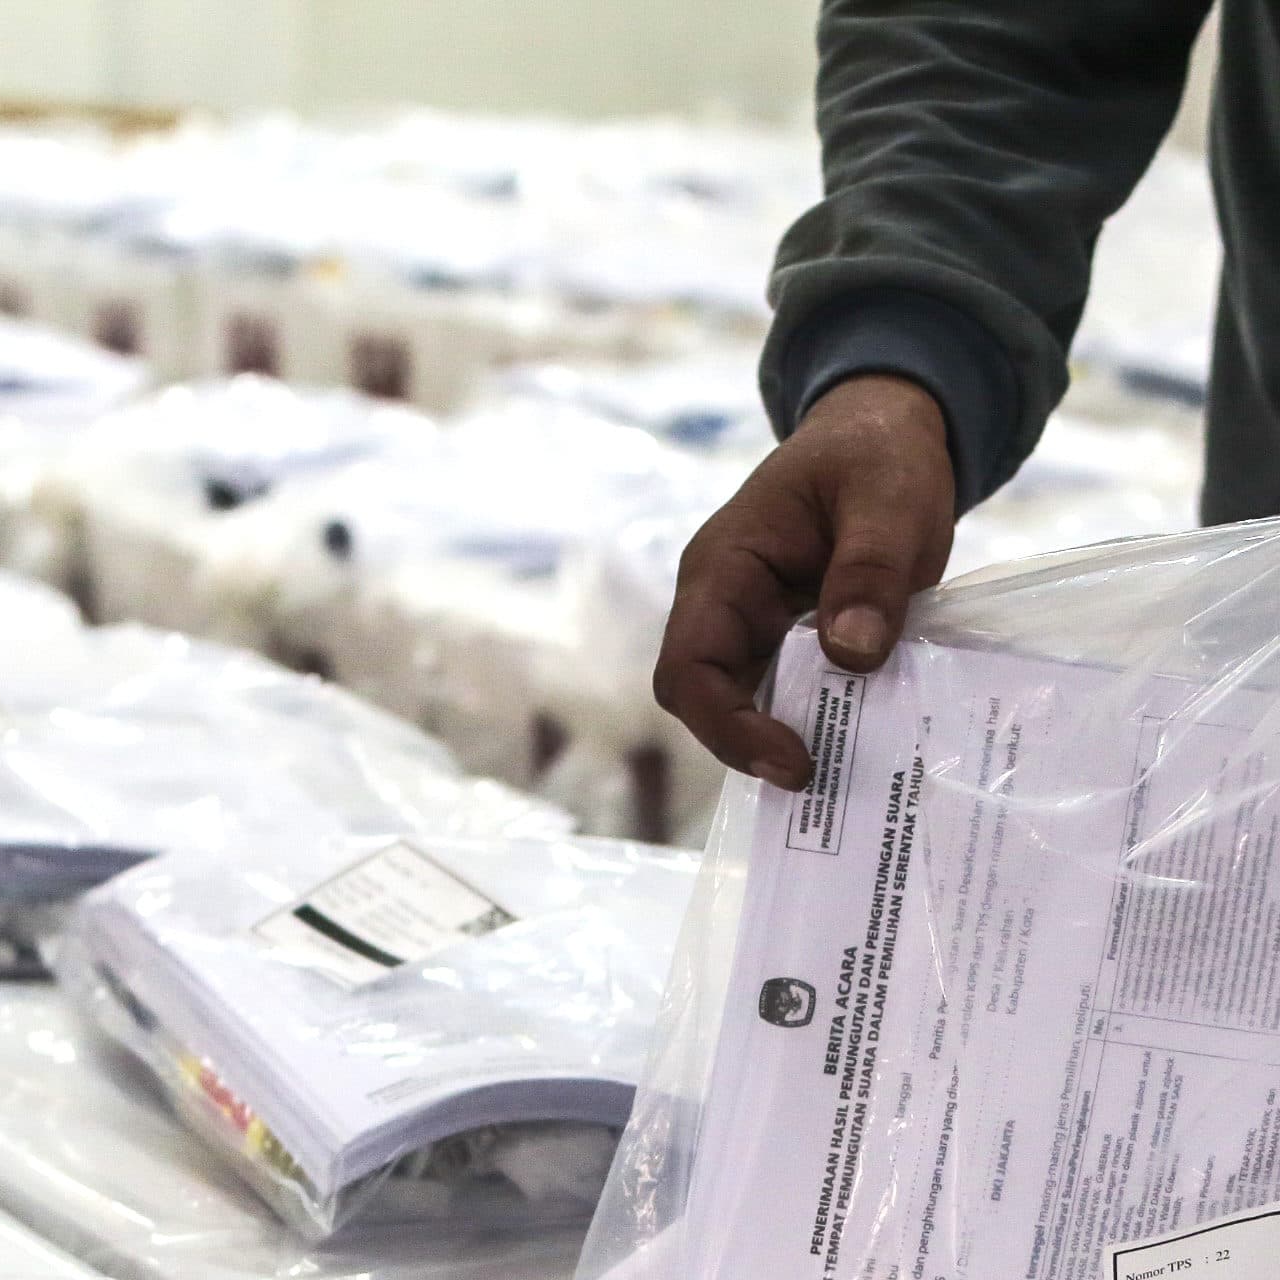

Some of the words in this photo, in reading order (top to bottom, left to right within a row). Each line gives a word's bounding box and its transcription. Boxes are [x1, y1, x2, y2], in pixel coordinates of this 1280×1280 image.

[828, 696, 840, 720] DAN
[839, 699, 852, 726] DARI
[843, 678, 855, 698] TPS
[798, 798, 812, 834] BERITA
[810, 686, 829, 756] PENERIMAAN
[817, 722, 836, 796] PEMUNGUTAN
[833, 728, 847, 764] SUARA
[820, 766, 841, 849] PENGHITUNGAN
[884, 769, 905, 823] SUARA
[905, 754, 926, 809] TAHUN
[812, 797, 825, 828] HASIL
[890, 812, 916, 890] SERENTAK
[928, 1017, 947, 1060] Panitia
[984, 696, 1001, 725] hasil
[862, 826, 895, 949] PENGHITUNGAN
[875, 893, 902, 980] PEMILIHAN
[1006, 948, 1028, 1015] Kabupaten
[1018, 906, 1035, 938] Kota
[833, 944, 858, 1009] ACARA
[855, 951, 874, 988] DAN
[864, 983, 886, 1041] DALAM
[823, 1013, 846, 1075] BERITA
[836, 990, 867, 1099] PEMUNGUTAN
[854, 1045, 875, 1098] SUARA
[892, 1071, 913, 1119] tanggal
[938, 1101, 957, 1131] yang
[828, 1103, 847, 1148] HASIL
[932, 1132, 951, 1166] suara
[995, 1118, 1016, 1175] JAKARTA
[835, 1101, 865, 1209] PEMUNGUTAN
[809, 1152, 839, 1255] PENERIMAAN
[916, 1167, 945, 1253] penghitungan
[990, 1179, 1005, 1201] DKI
[1025, 1224, 1046, 1279] tersegel
[1036, 1131, 1064, 1222] masing-masing
[1053, 1101, 1070, 1130] jenis
[823, 1213, 846, 1273] TEMPAT
[911, 1255, 929, 1280] dan
[1168, 1257, 1193, 1274] TPS
[1215, 1249, 1231, 1262] 22
